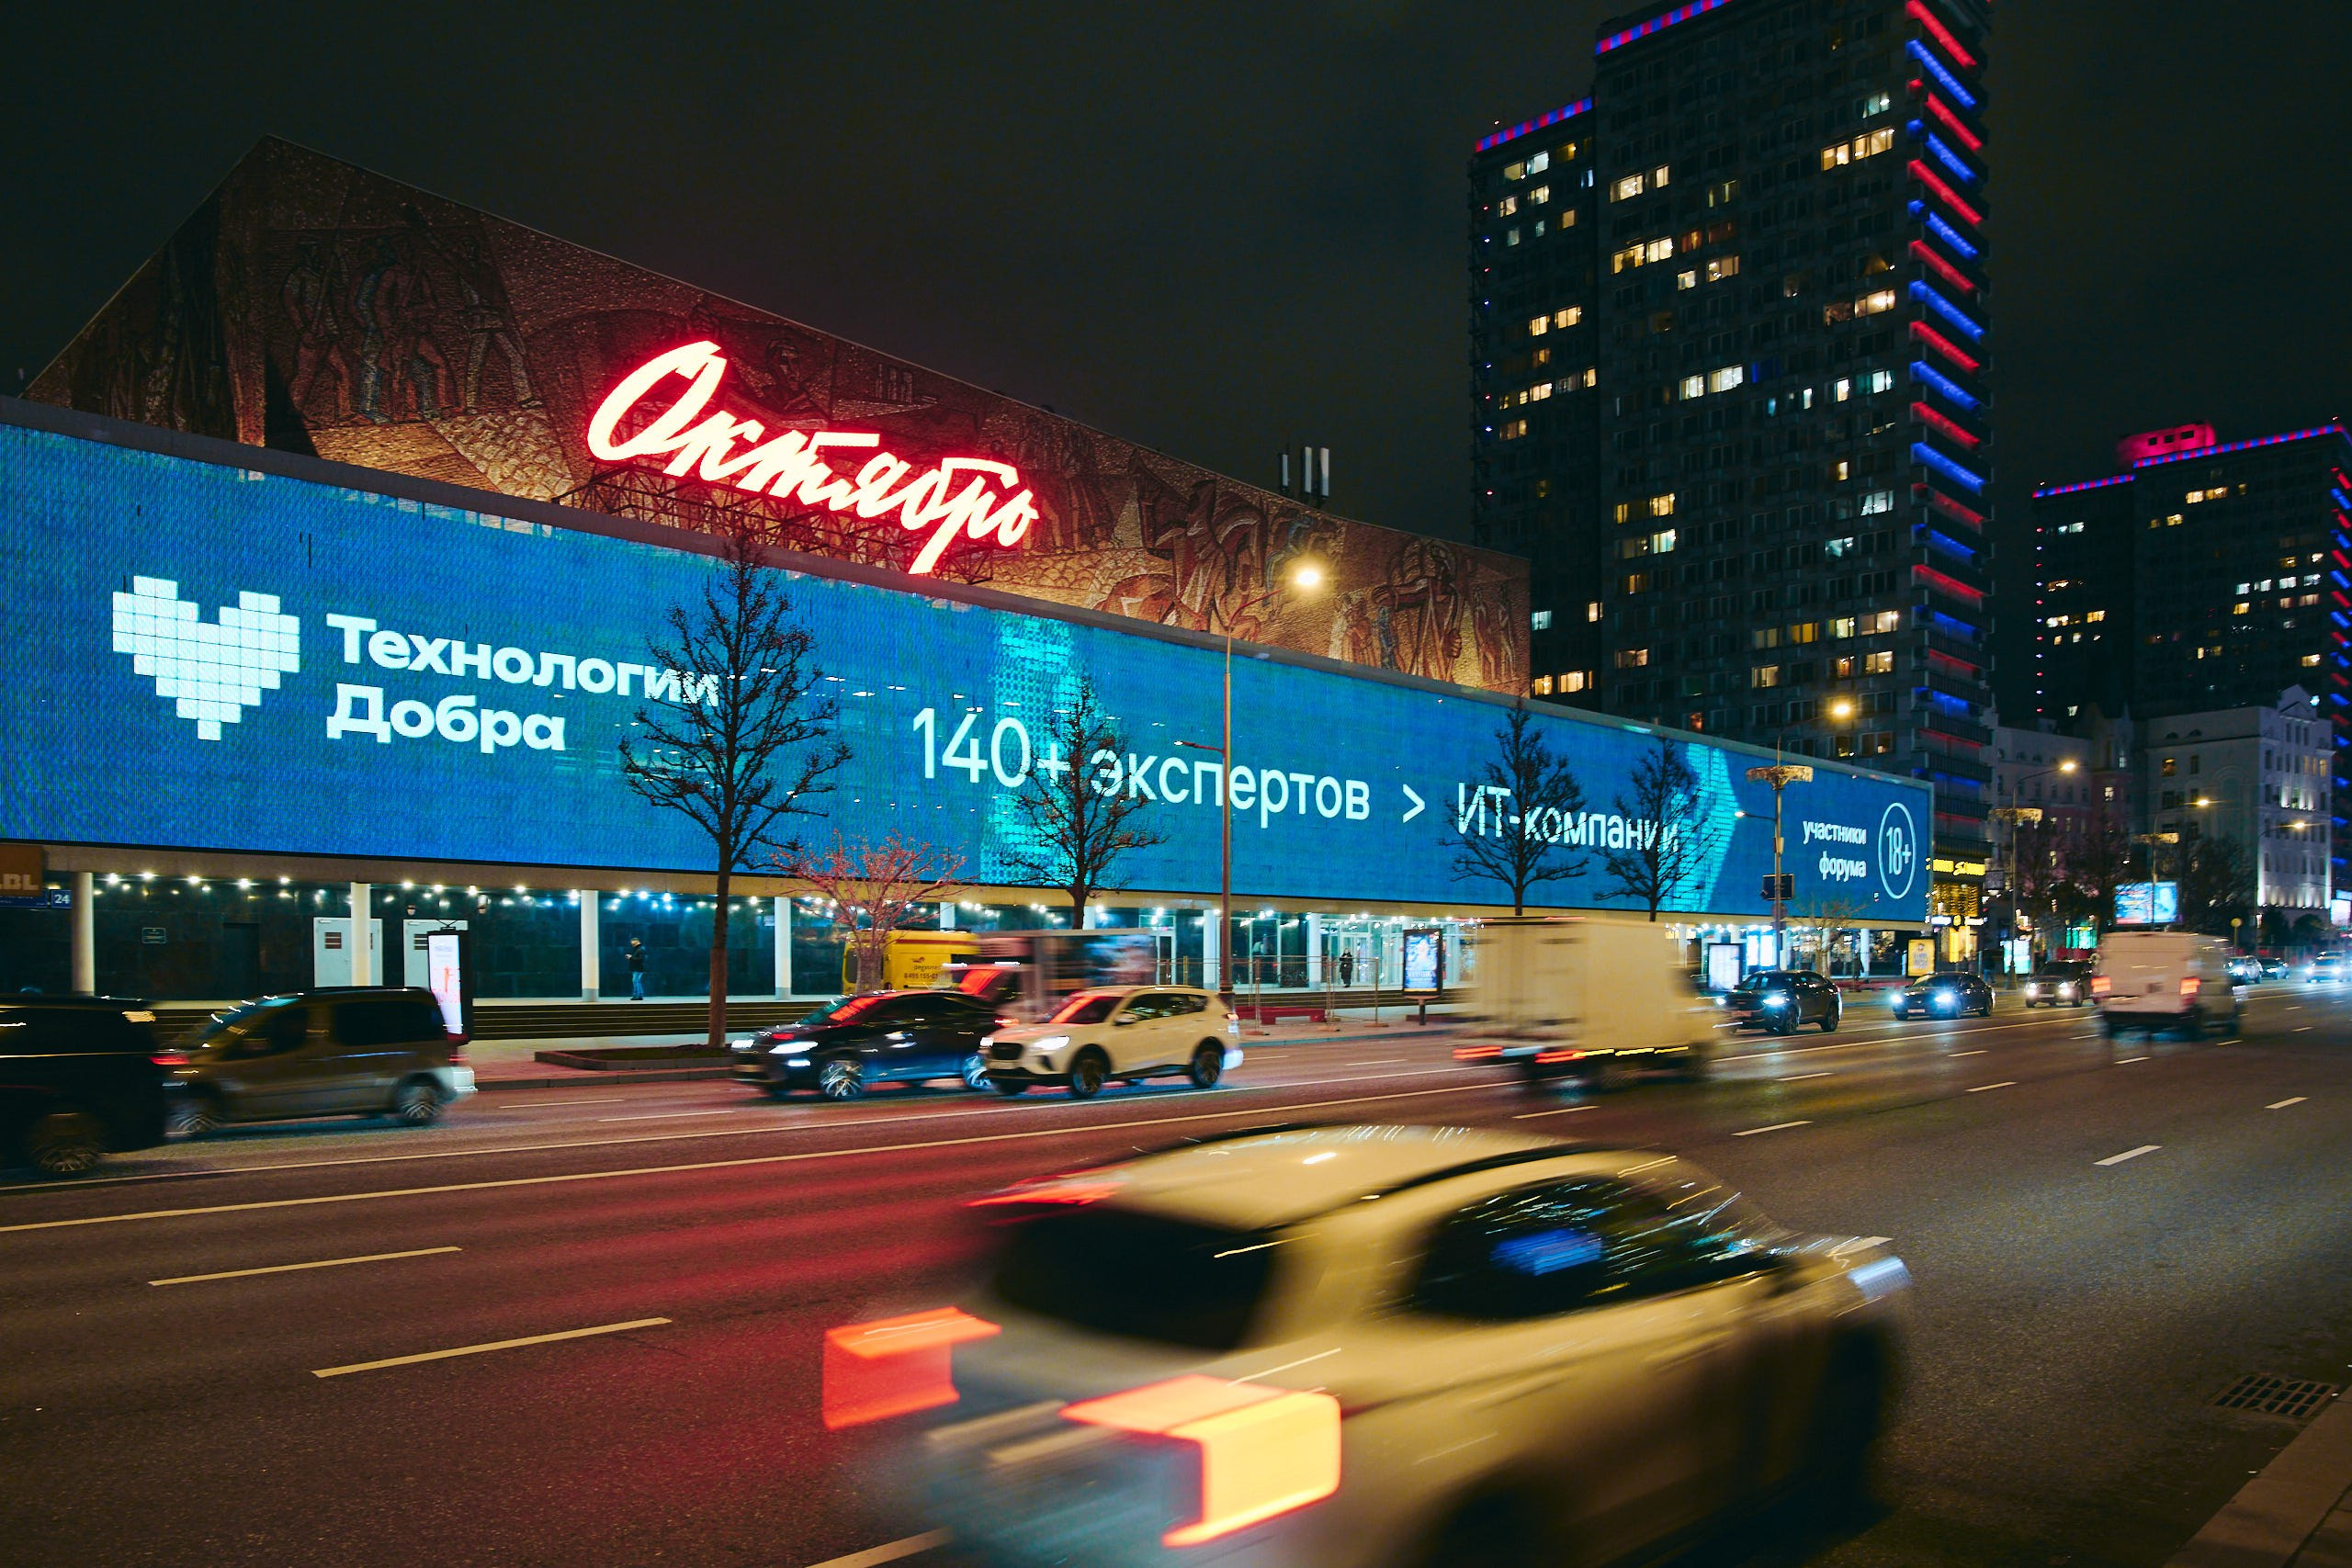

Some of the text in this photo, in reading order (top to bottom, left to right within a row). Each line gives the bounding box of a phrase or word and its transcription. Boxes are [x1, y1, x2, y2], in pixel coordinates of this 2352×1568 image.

[326, 613, 719, 707] Технологии
[326, 682, 565, 754] Добра
[912, 707, 1071, 787] 140+
[1090, 748, 1370, 829] экспертов
[1458, 782, 1679, 852] ИТ-компании
[1802, 820, 1867, 845] участники
[1886, 826, 1912, 875] 18+
[1818, 850, 1867, 882] форума
[54, 894, 71, 905] 24
